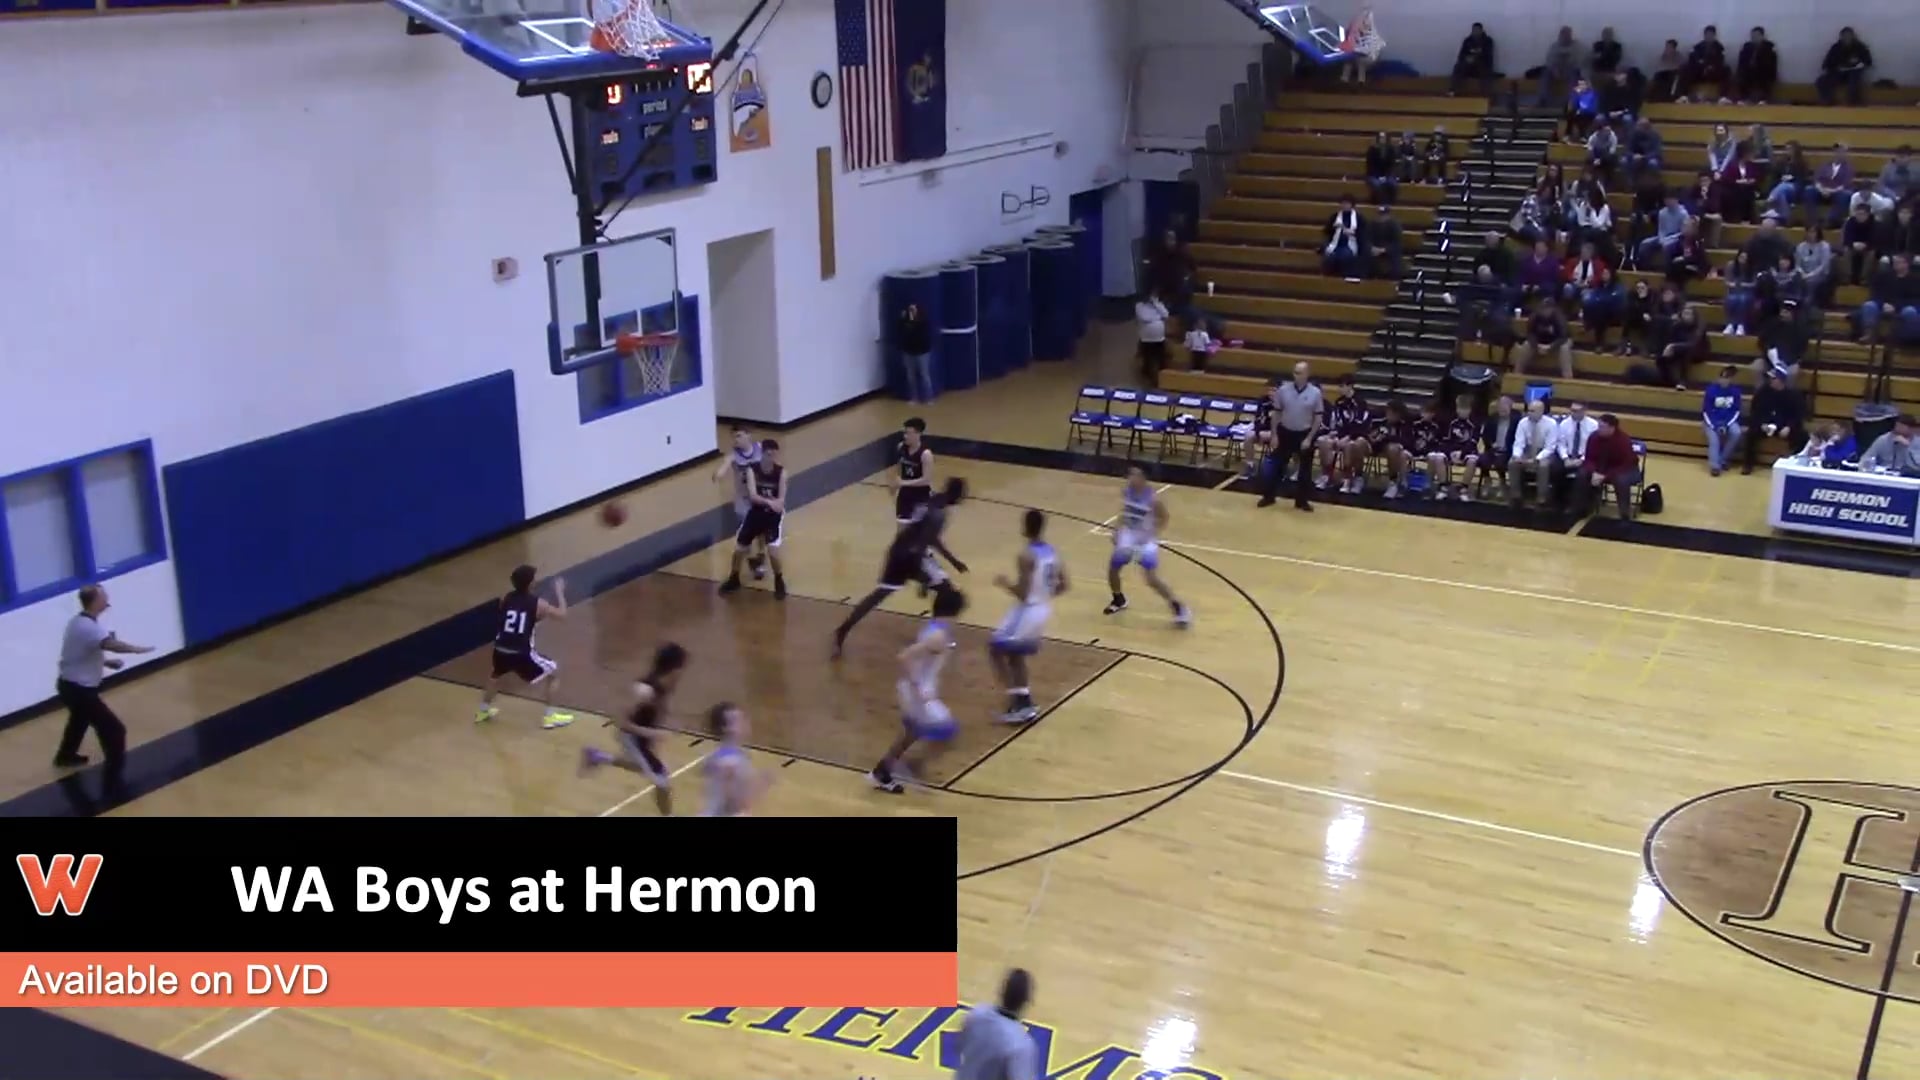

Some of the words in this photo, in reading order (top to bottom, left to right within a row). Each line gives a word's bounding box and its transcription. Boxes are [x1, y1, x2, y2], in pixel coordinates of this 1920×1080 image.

[1811, 488, 1891, 508] HERMON
[1788, 502, 1835, 518] HIGH
[1838, 508, 1909, 527] SCHOOL
[504, 610, 527, 633] 21
